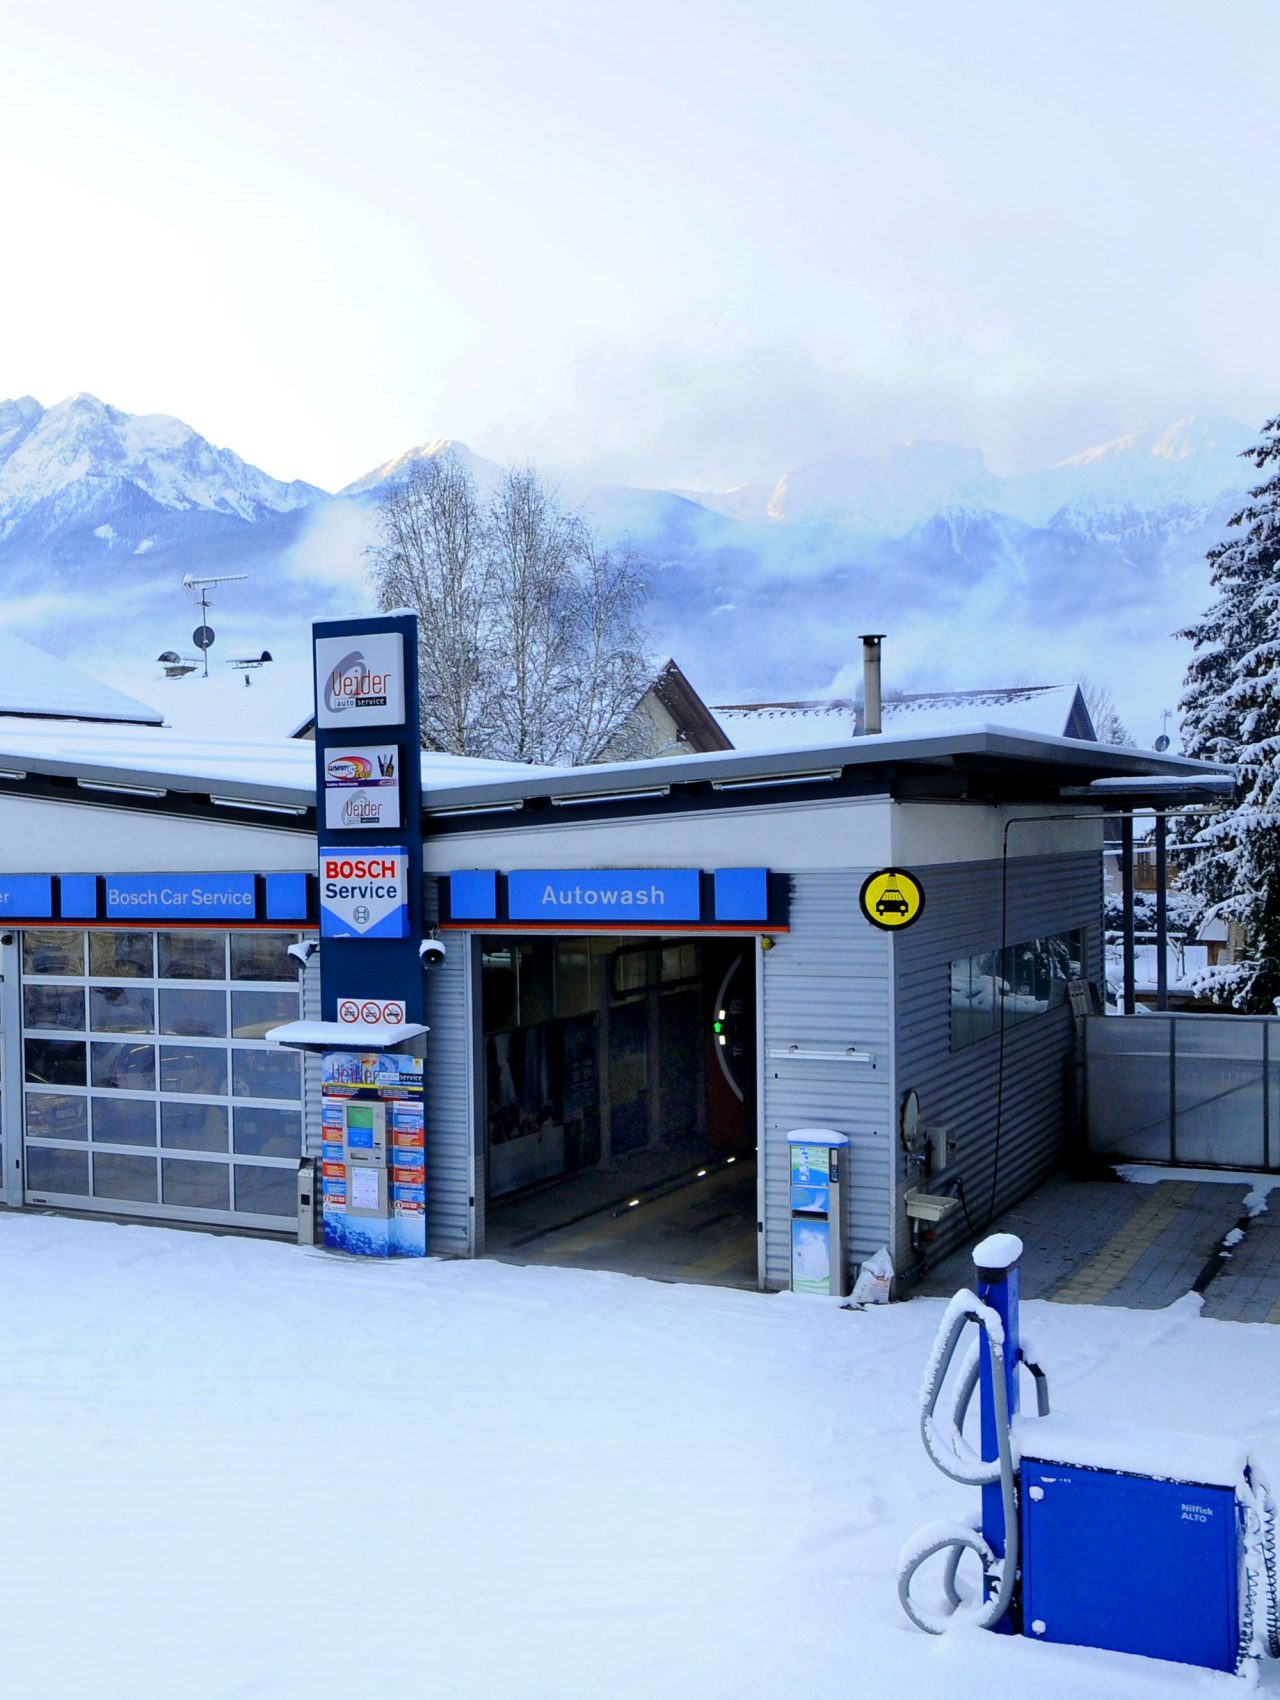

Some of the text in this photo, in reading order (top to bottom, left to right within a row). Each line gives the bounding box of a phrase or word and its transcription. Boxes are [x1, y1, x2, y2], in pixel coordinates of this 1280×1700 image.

[357, 698, 385, 706] service
[326, 860, 396, 879] BOSCH
[108, 889, 253, 905] Bosch Car Service
[326, 881, 397, 899] Service
[541, 885, 665, 905] Autowash
[399, 1073, 423, 1081] service
[1181, 1503, 1213, 1515] Nilfisk
[1181, 1512, 1207, 1522] ALTO
